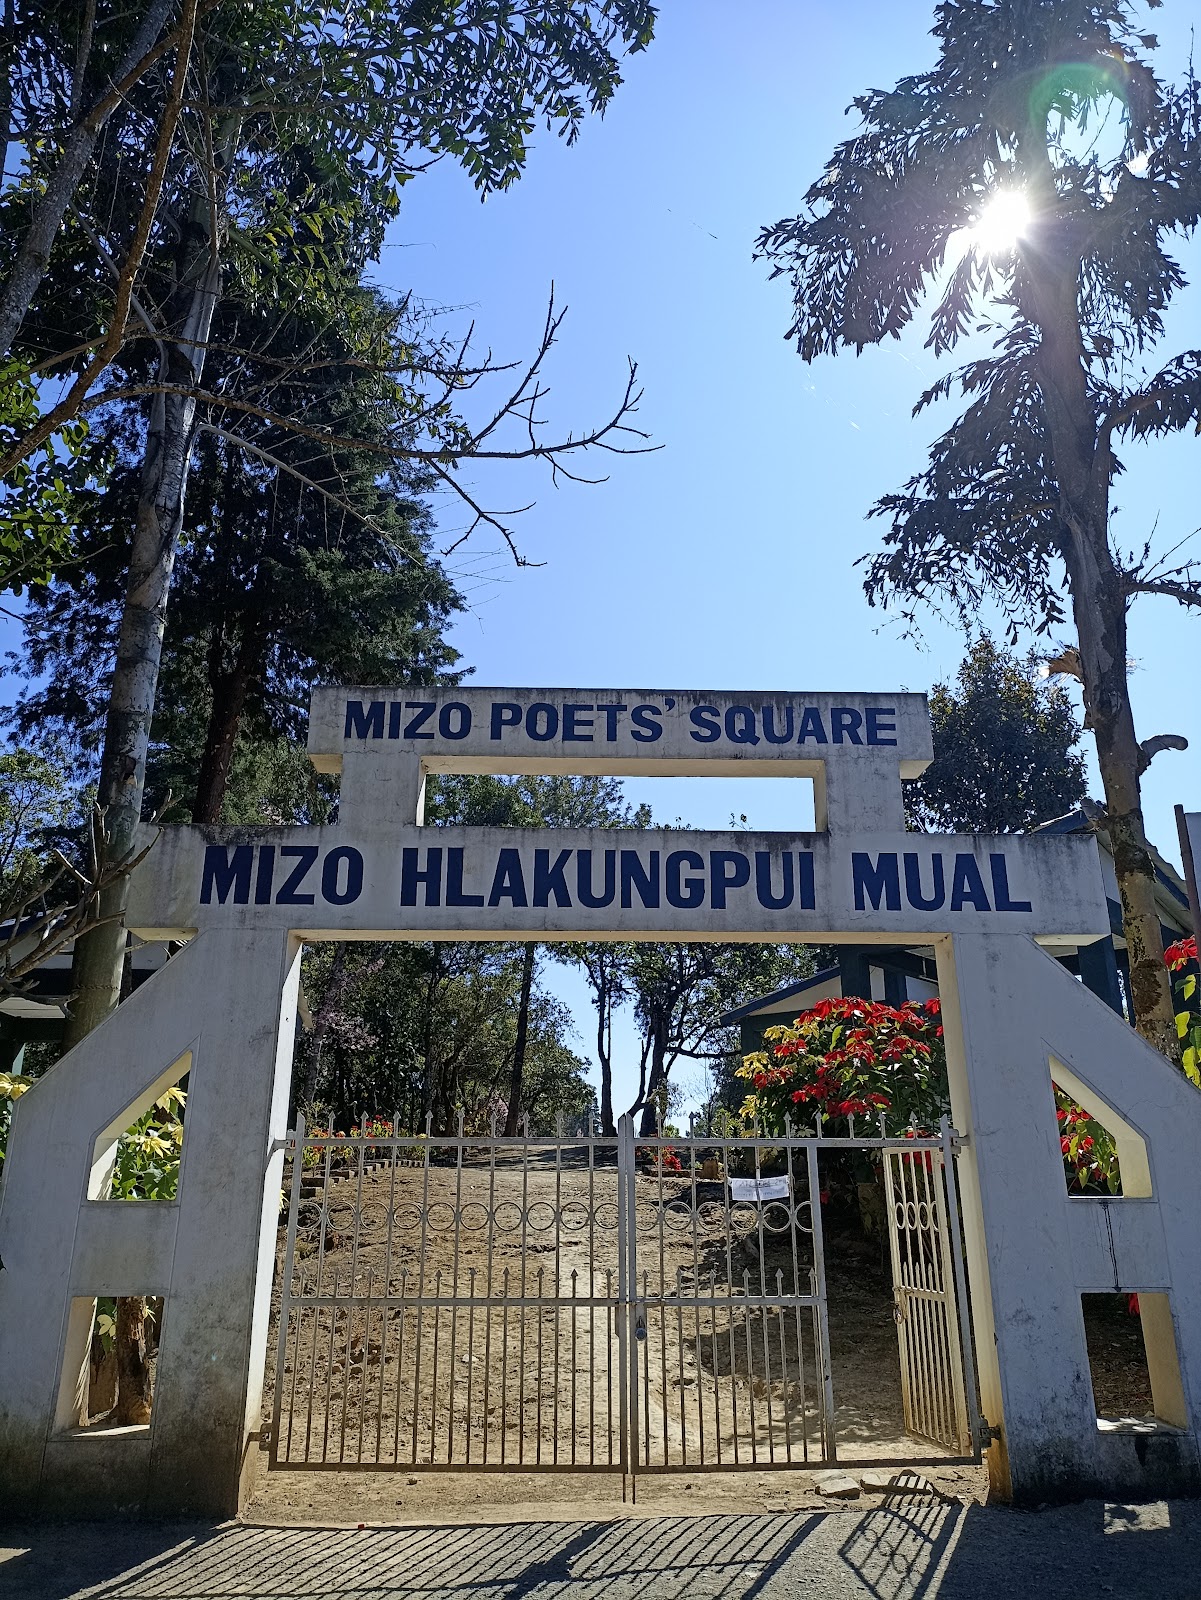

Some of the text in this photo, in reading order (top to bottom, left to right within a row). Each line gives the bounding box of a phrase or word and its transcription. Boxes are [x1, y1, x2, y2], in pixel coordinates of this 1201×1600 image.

[344, 698, 897, 746] MIZO POETS' SQUARE
[200, 845, 1032, 912] MIZO HLAKUNGPUI MUAL
